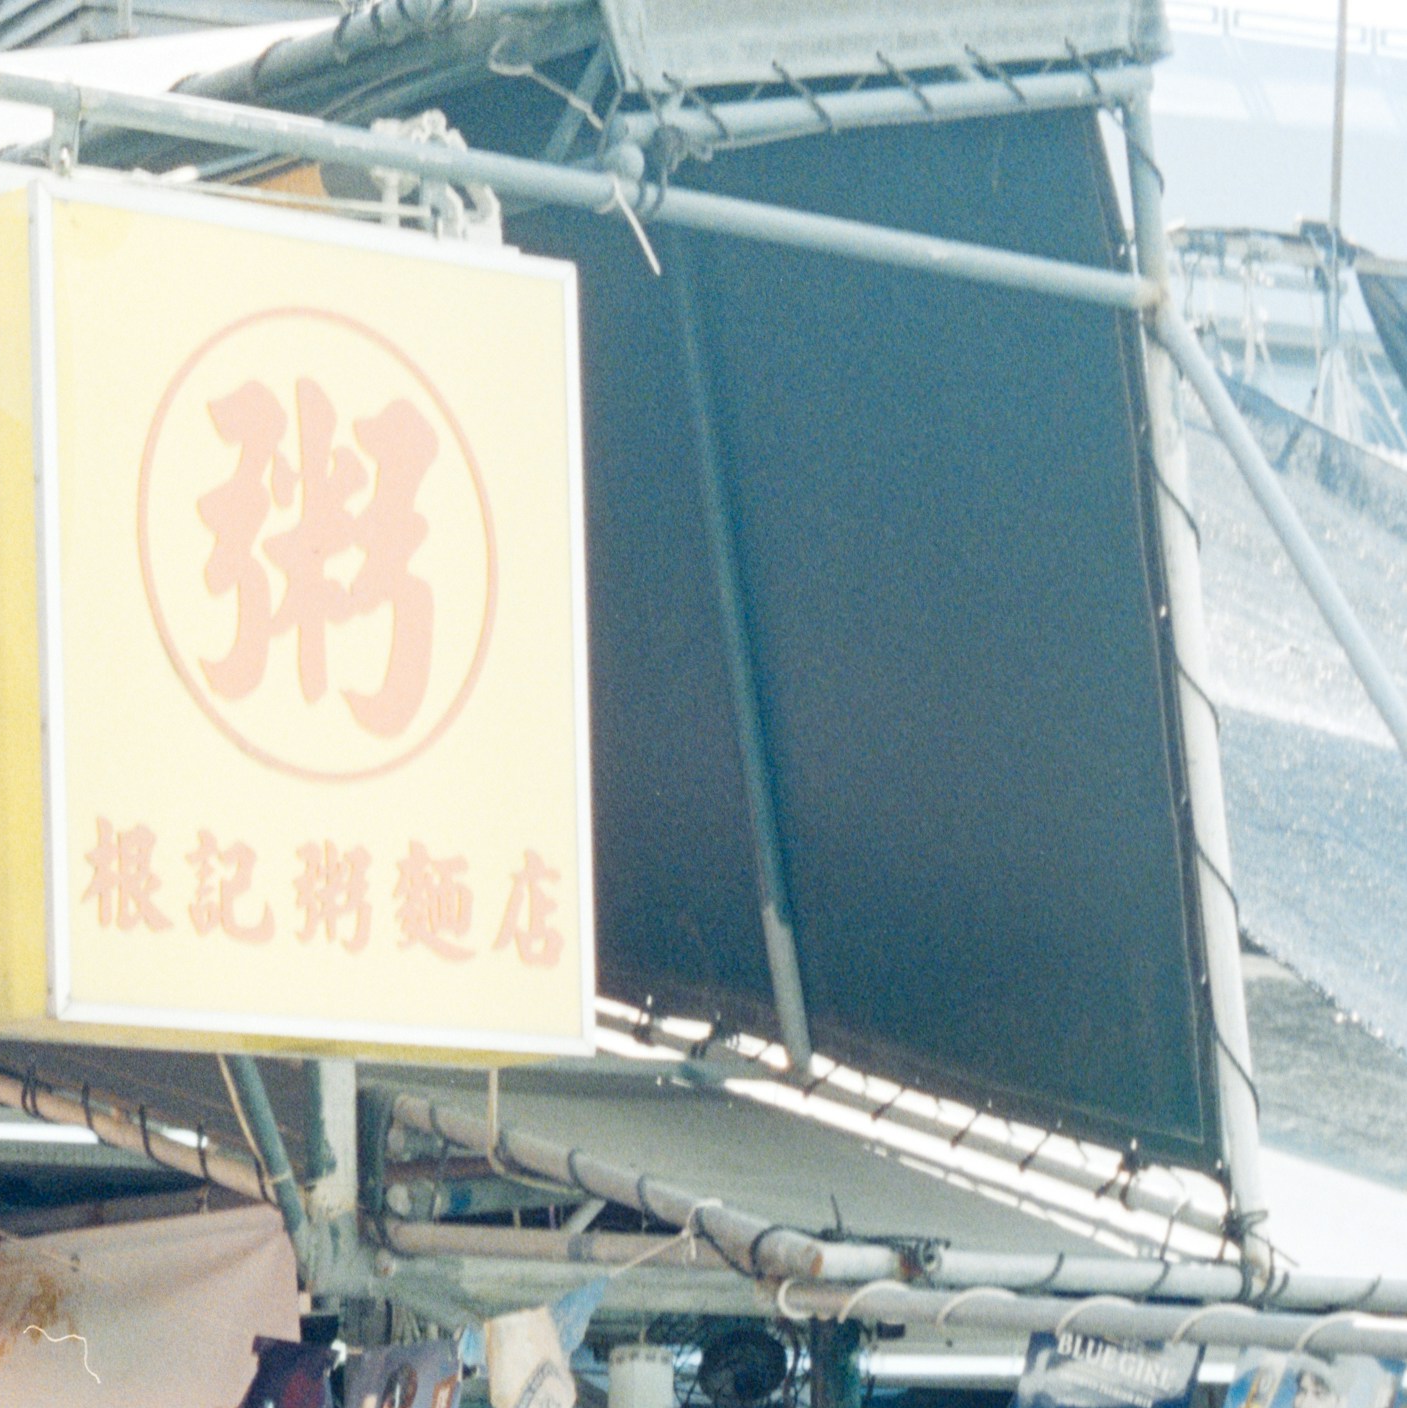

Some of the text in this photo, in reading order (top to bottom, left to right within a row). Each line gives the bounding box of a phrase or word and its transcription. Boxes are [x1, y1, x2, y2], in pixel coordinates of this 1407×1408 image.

[197, 375, 440, 742] 粥
[81, 814, 565, 969] 根記粥麵店
[1058, 1331, 1118, 1371] BLUE
